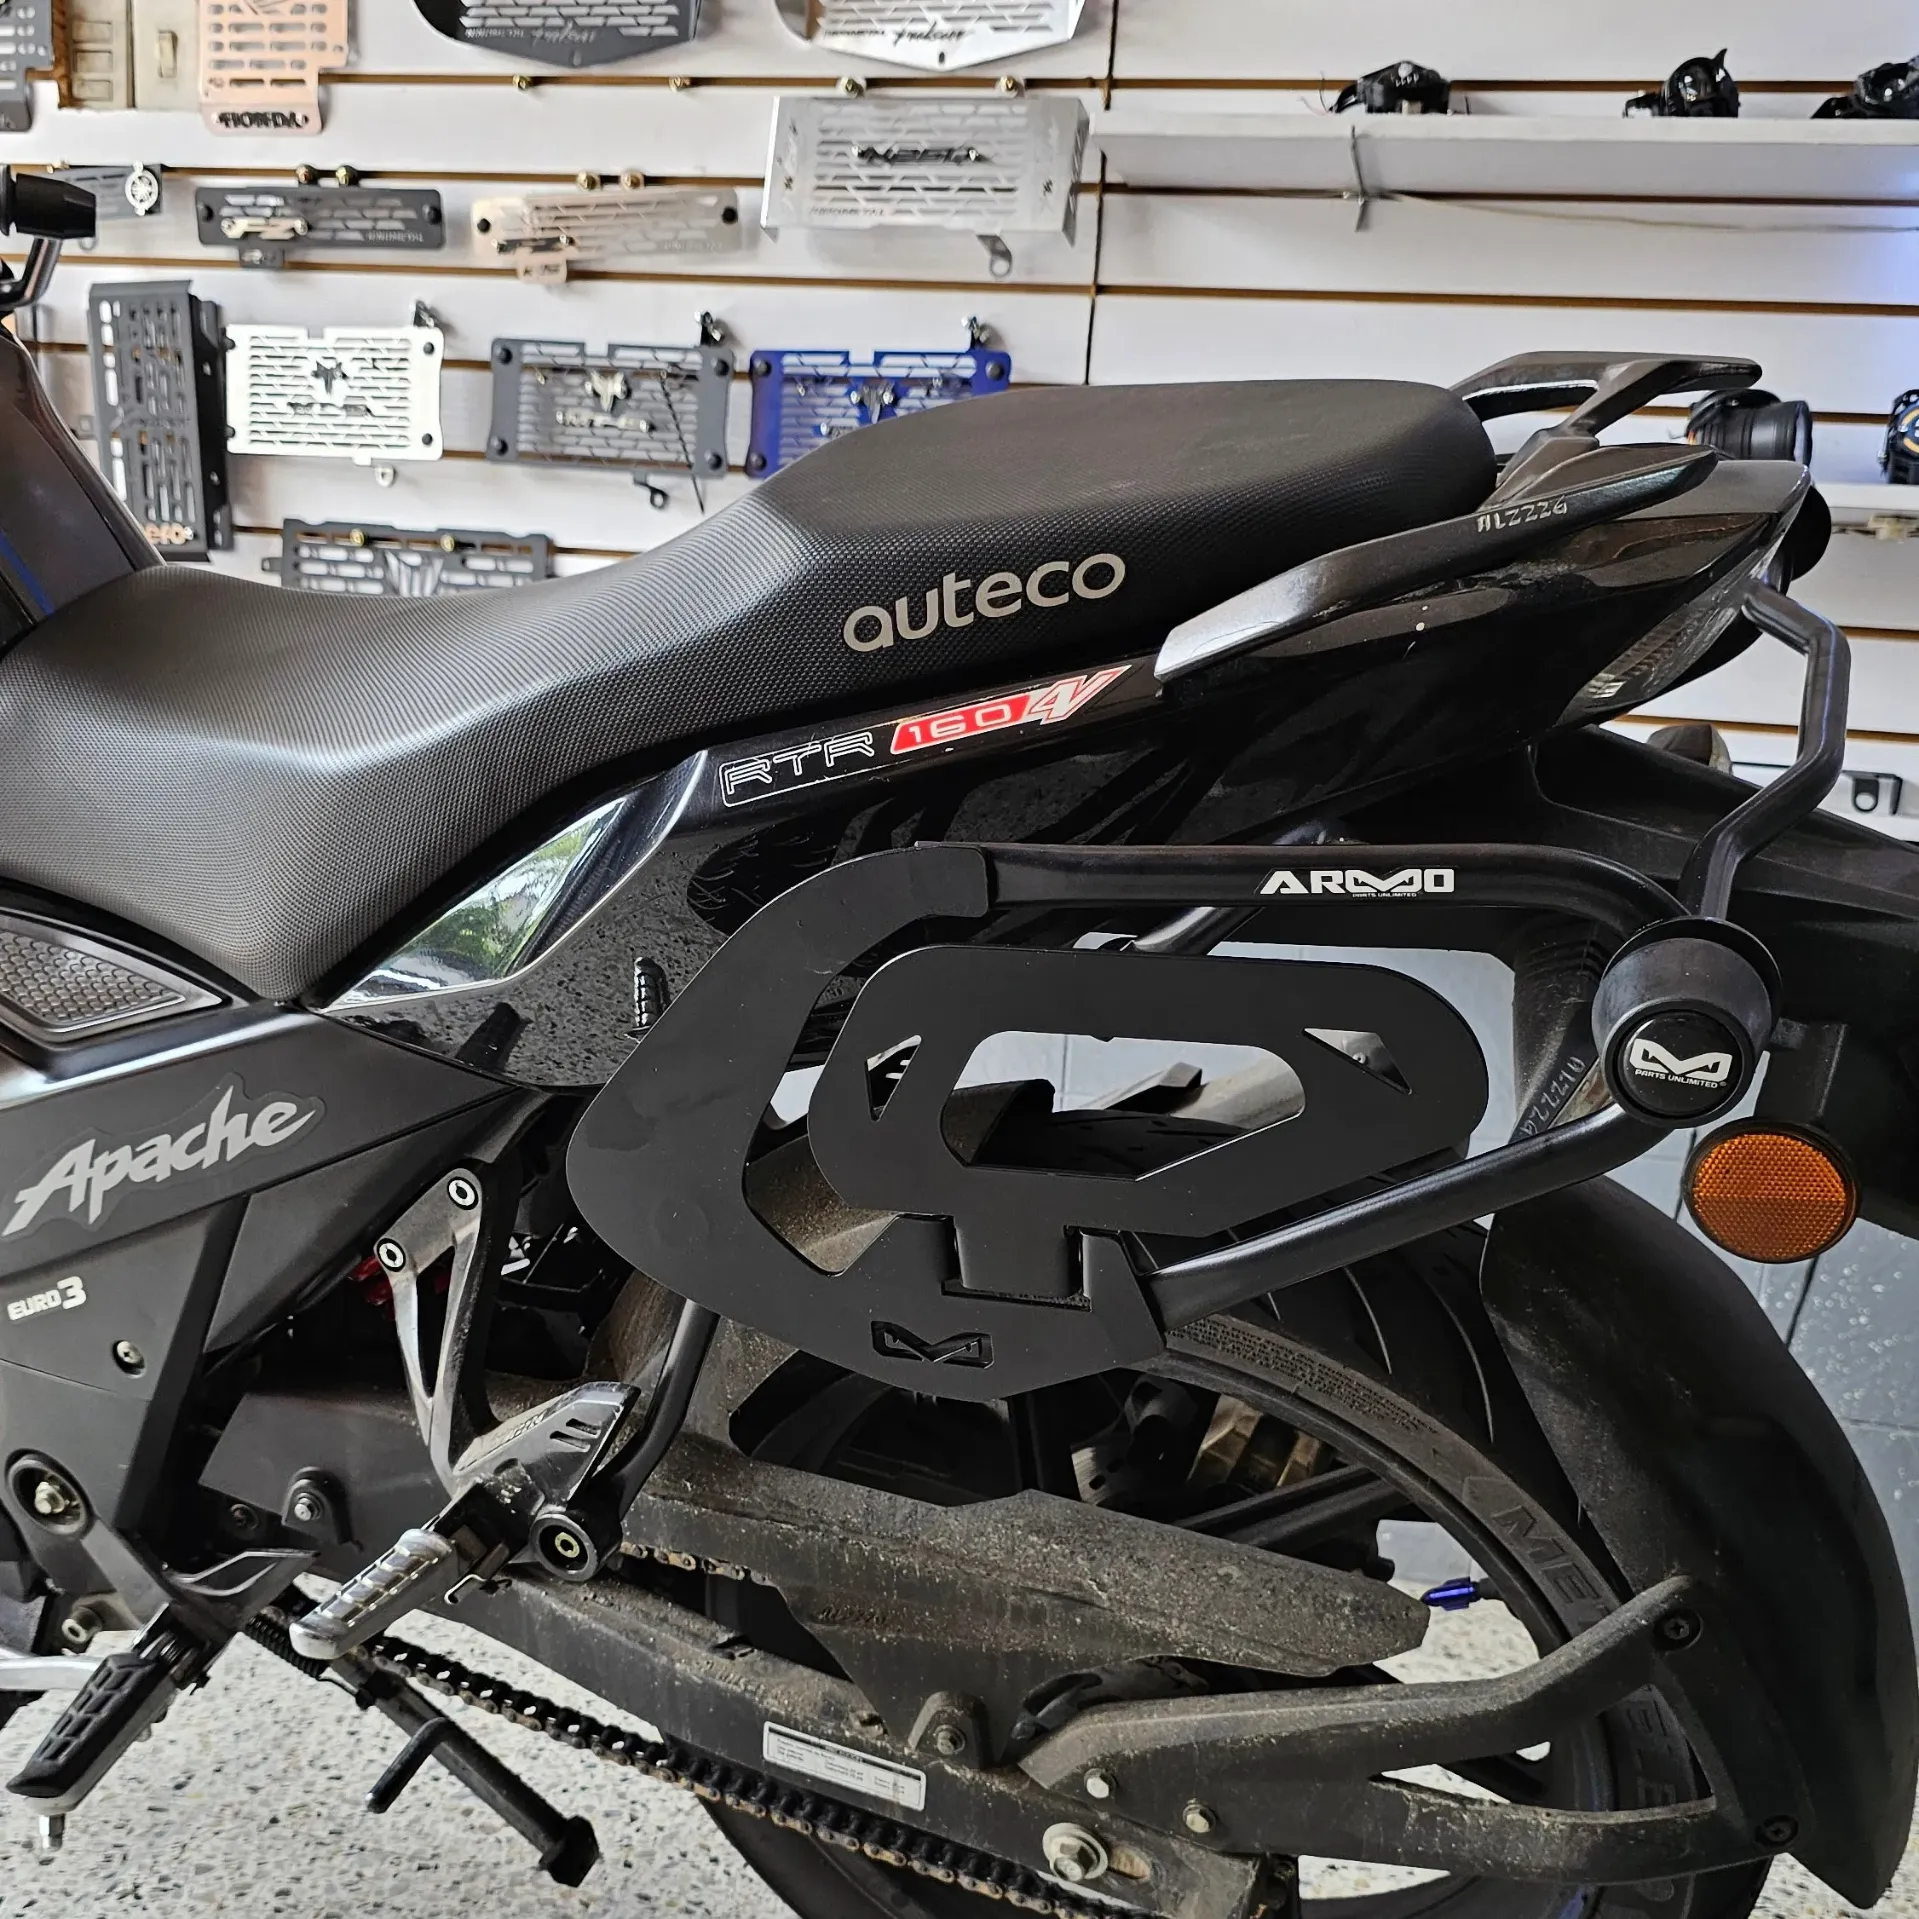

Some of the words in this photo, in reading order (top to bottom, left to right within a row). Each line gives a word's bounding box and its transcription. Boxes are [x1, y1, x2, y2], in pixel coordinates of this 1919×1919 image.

[843, 553, 1126, 652] auteco
[726, 731, 875, 796] RTR
[908, 702, 1013, 744] 160
[1634, 1068, 1666, 1080] PARTS
[1667, 1075, 1719, 1089] UNLIMITED
[1, 1085, 317, 1238] Apache
